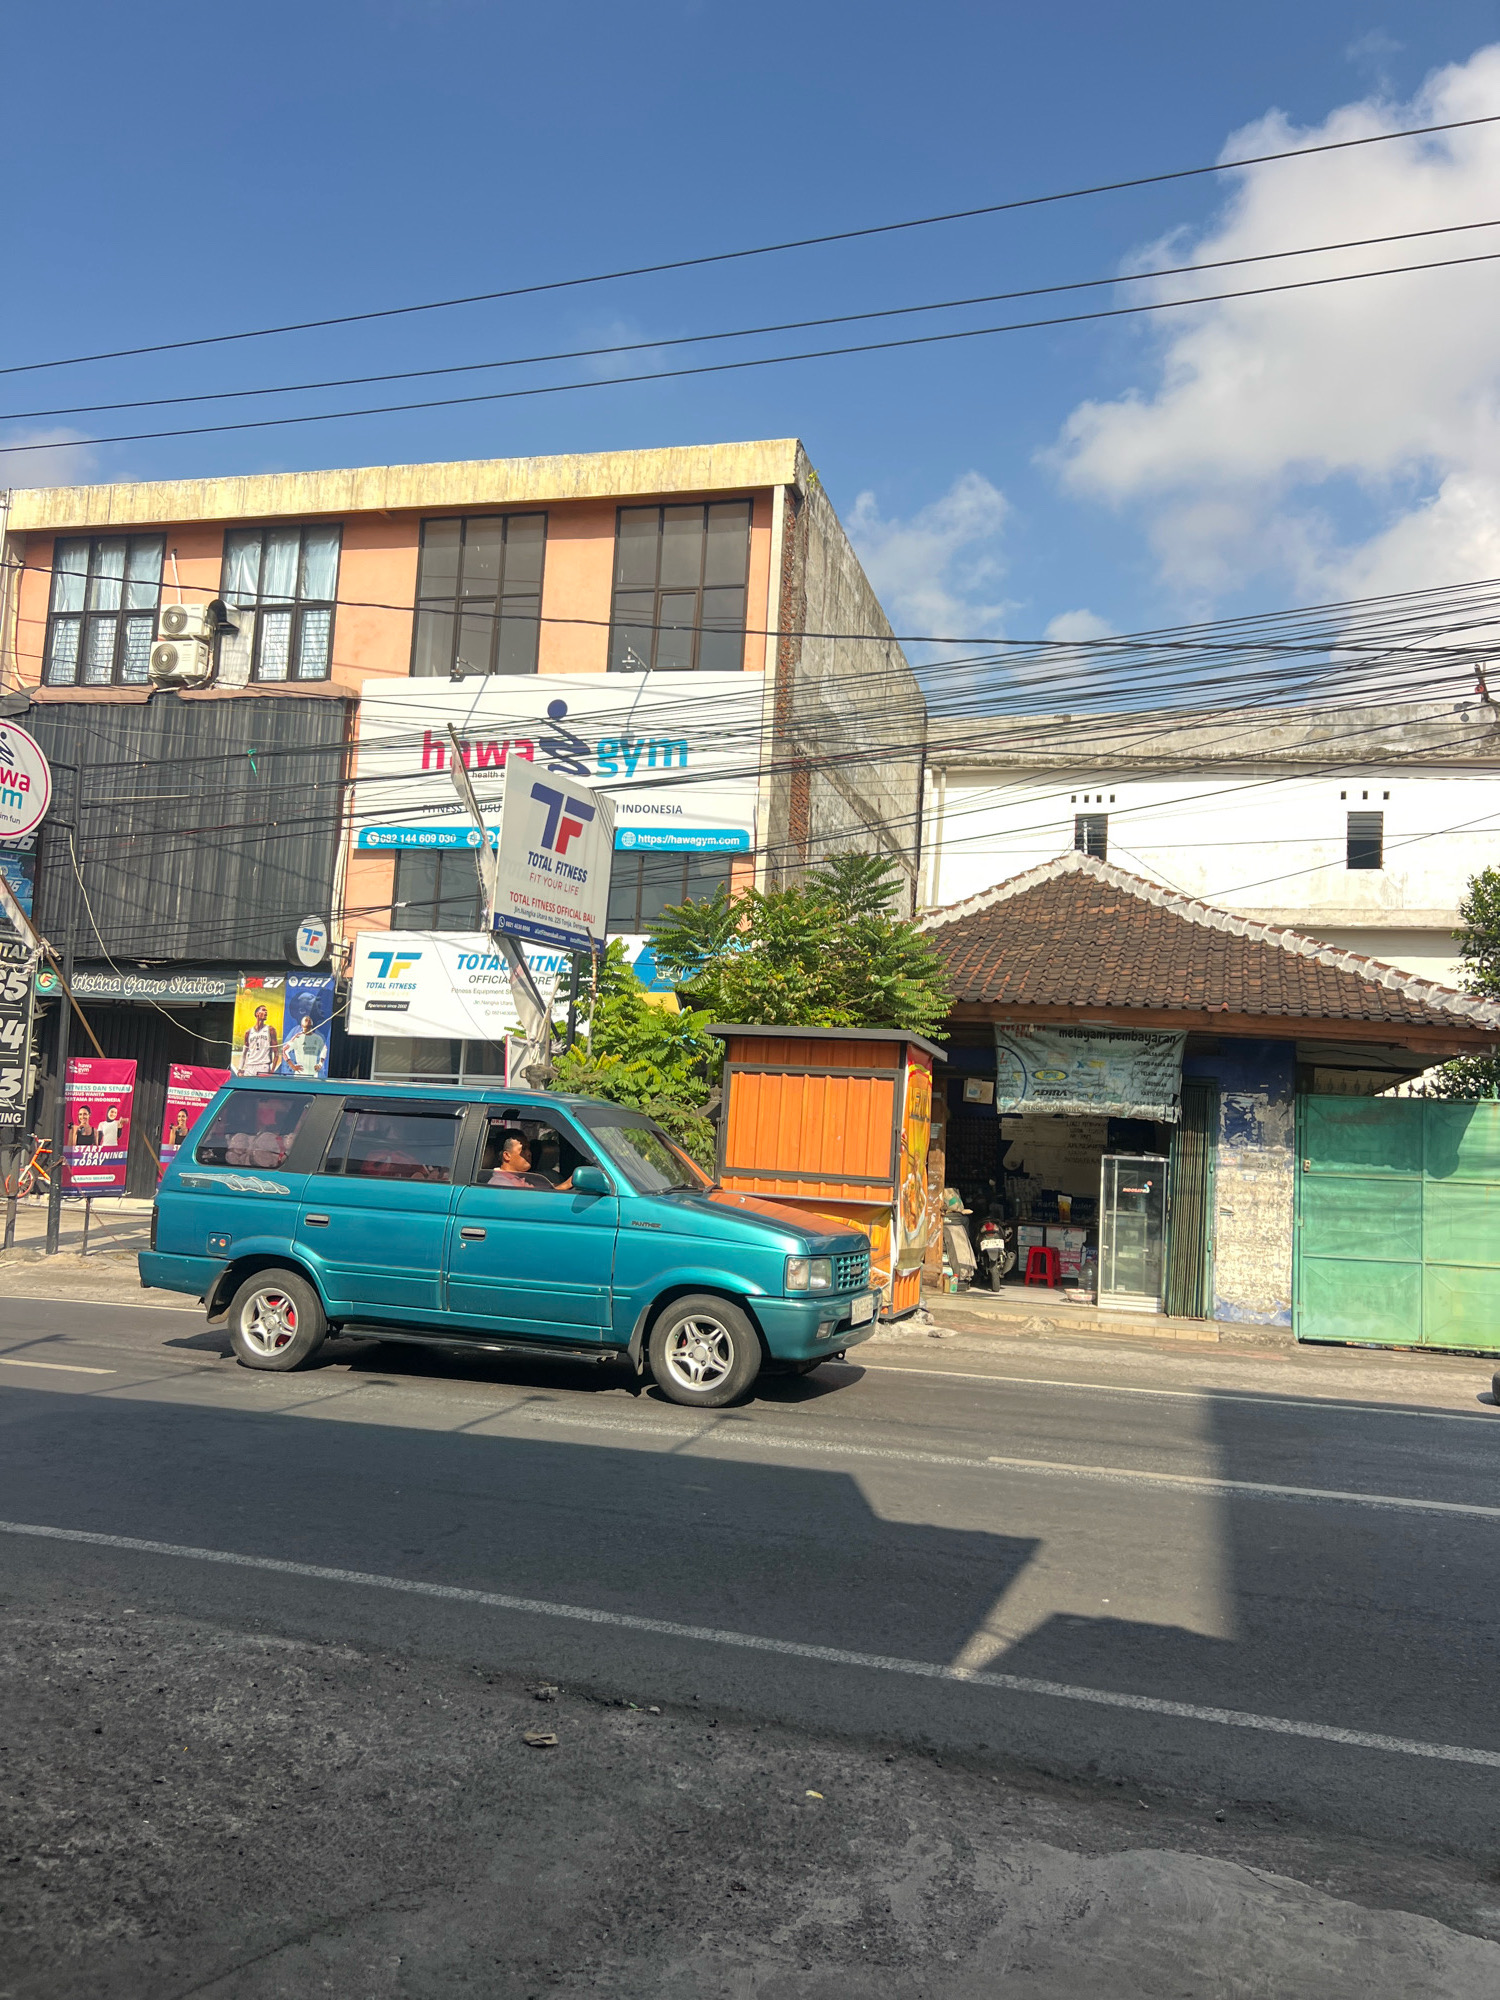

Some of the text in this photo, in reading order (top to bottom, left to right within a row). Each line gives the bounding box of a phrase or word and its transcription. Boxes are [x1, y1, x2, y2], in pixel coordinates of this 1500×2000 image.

[595, 737, 688, 778] gym
[0, 766, 31, 793] wa
[622, 804, 683, 815] INDONESIA
[400, 833, 417, 844] 144
[419, 833, 437, 844] 609
[438, 833, 457, 844] 030
[637, 834, 740, 847] https://hawagym.com
[527, 851, 588, 884] TOTAL FITNESS
[529, 872, 580, 896] FIT YOUR LIFE
[510, 891, 596, 924] TOTAL FITNESS OFFICIAL BALI
[457, 953, 509, 971] TOTAL
[123, 974, 168, 996] Game
[169, 975, 226, 996] Station
[366, 981, 417, 990] TOTAL FITNESS
[1059, 1028, 1176, 1046] melayani pembayaran
[73, 1145, 104, 1153] START
[82, 1151, 124, 1160] TRAINING
[73, 1158, 105, 1167] TODAY
[631, 1220, 662, 1229] PANTHER
